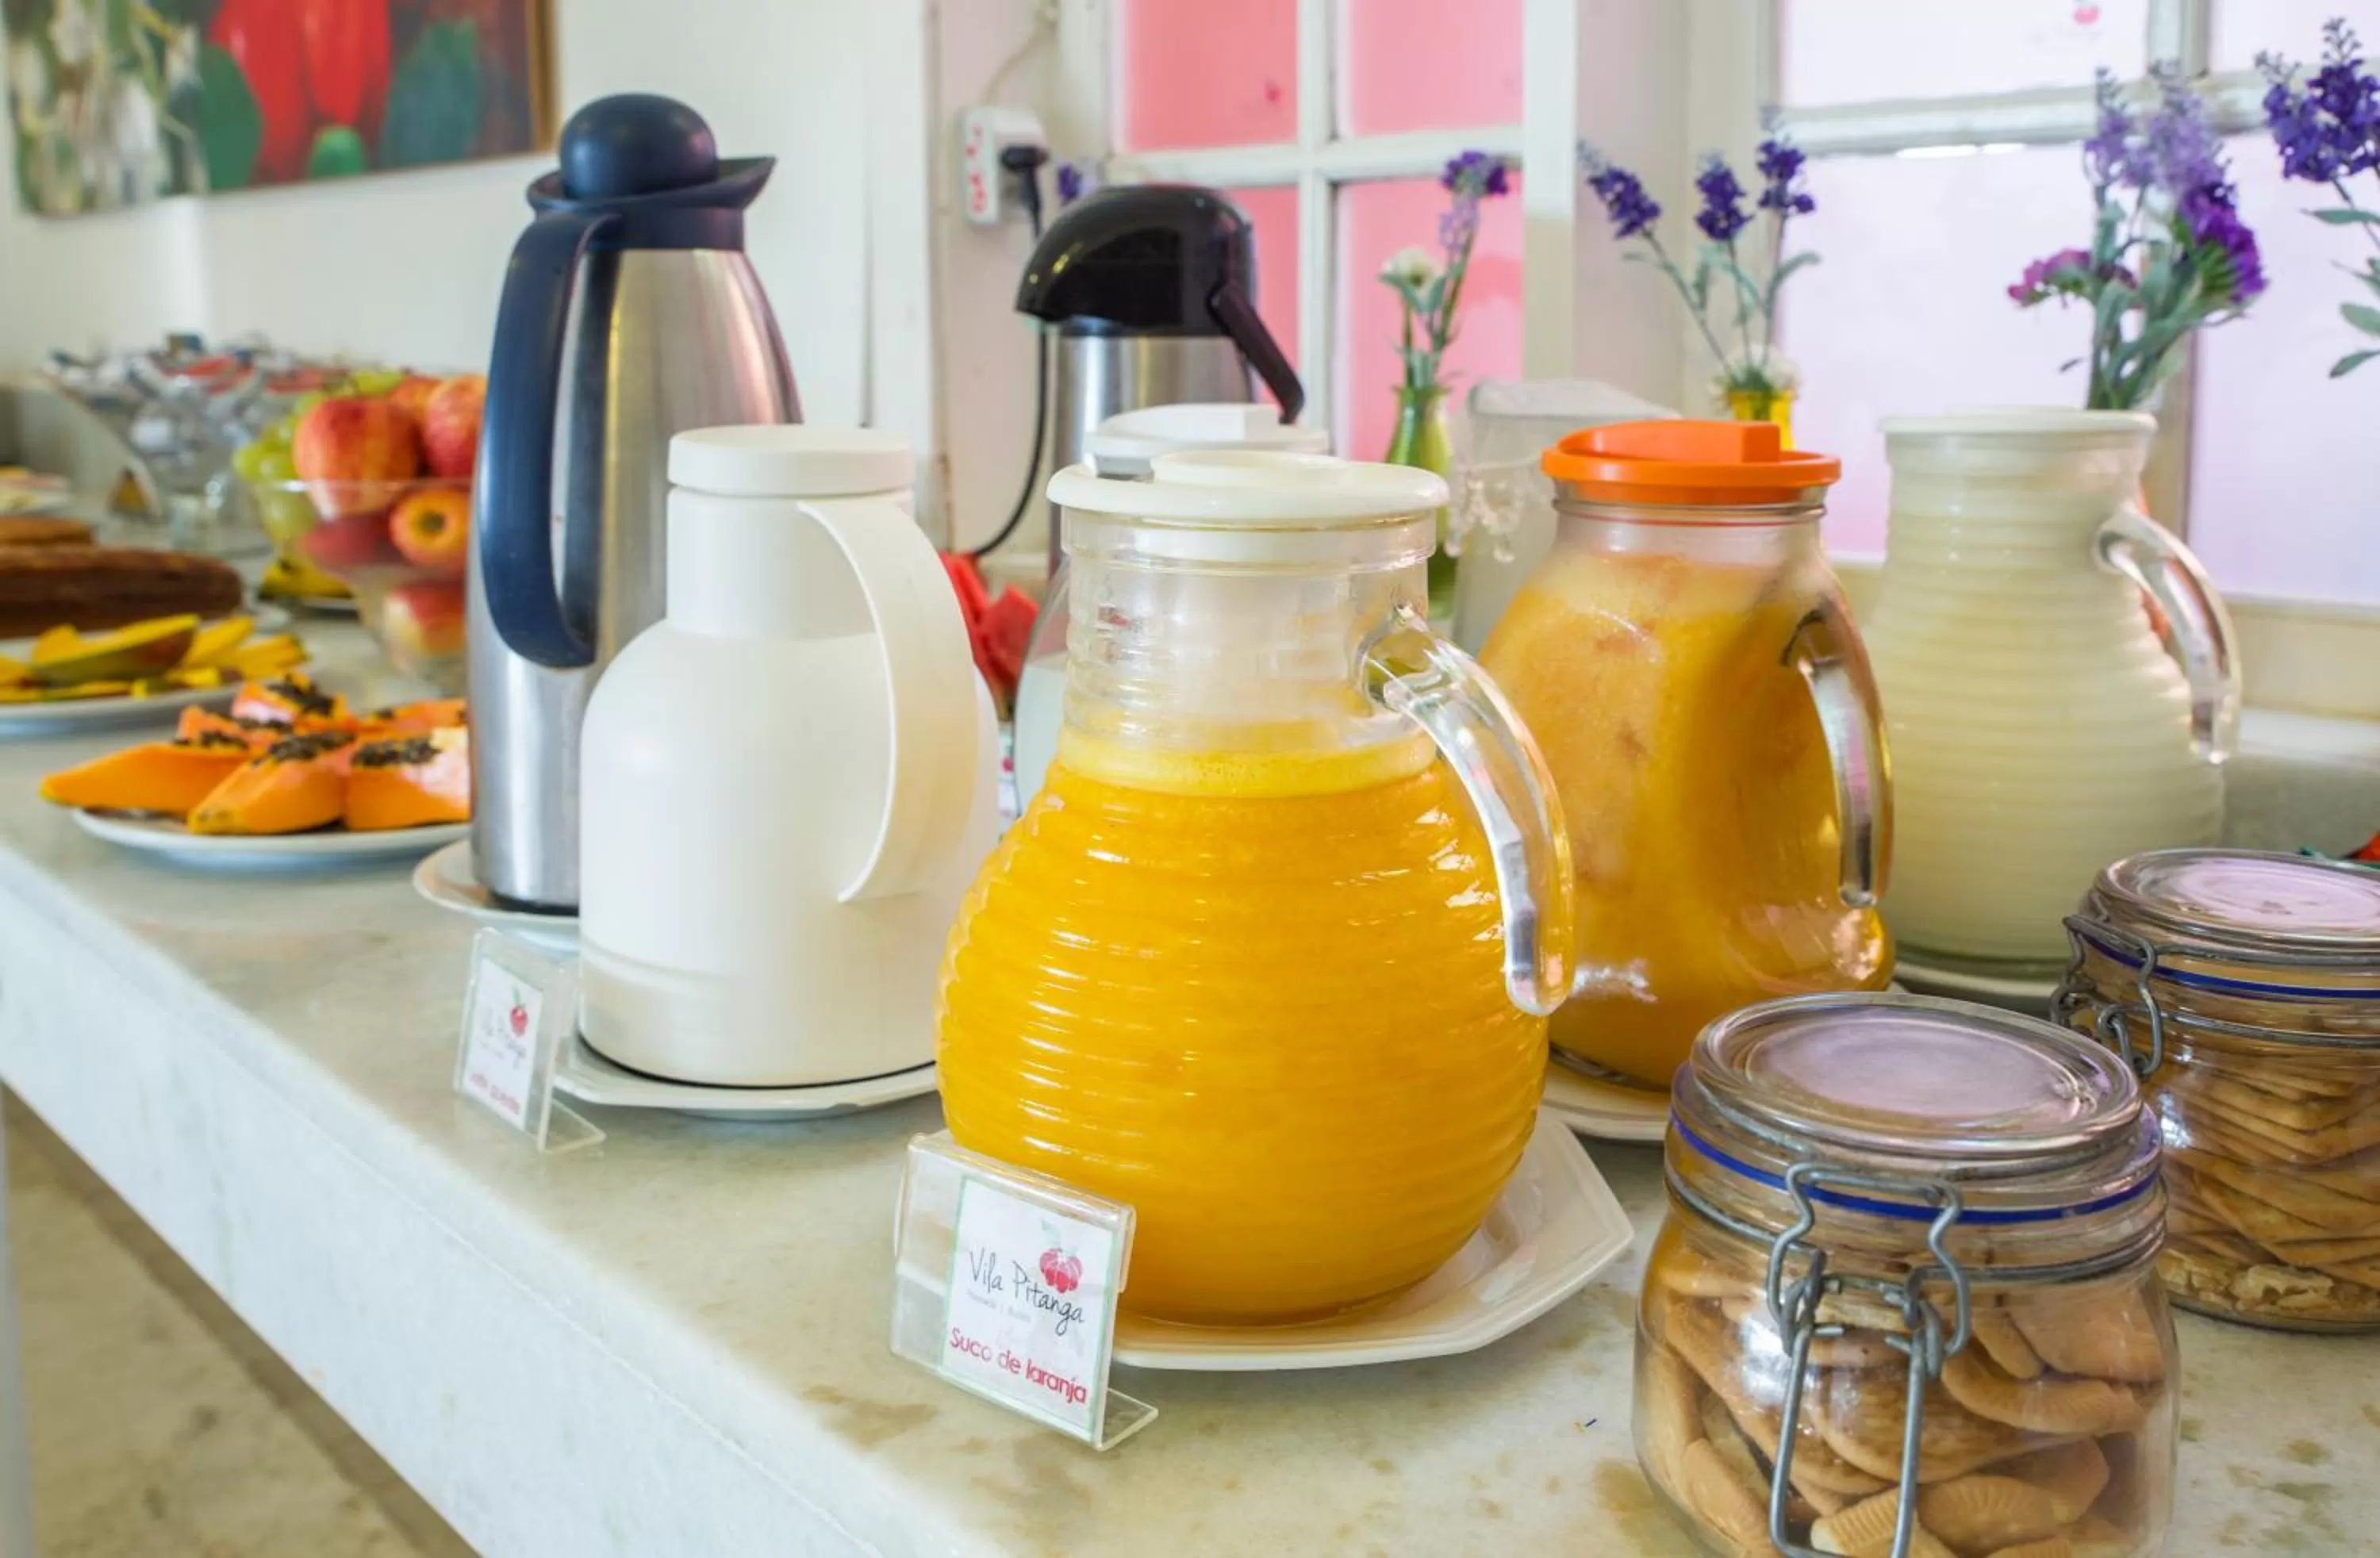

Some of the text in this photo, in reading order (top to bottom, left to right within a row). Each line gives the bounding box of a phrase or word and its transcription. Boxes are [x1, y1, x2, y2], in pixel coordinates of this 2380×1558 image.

[969, 1247, 1003, 1293] Vila
[1012, 1260, 1085, 1336] Pitanga
[950, 1328, 1087, 1404] Suco de laranja
